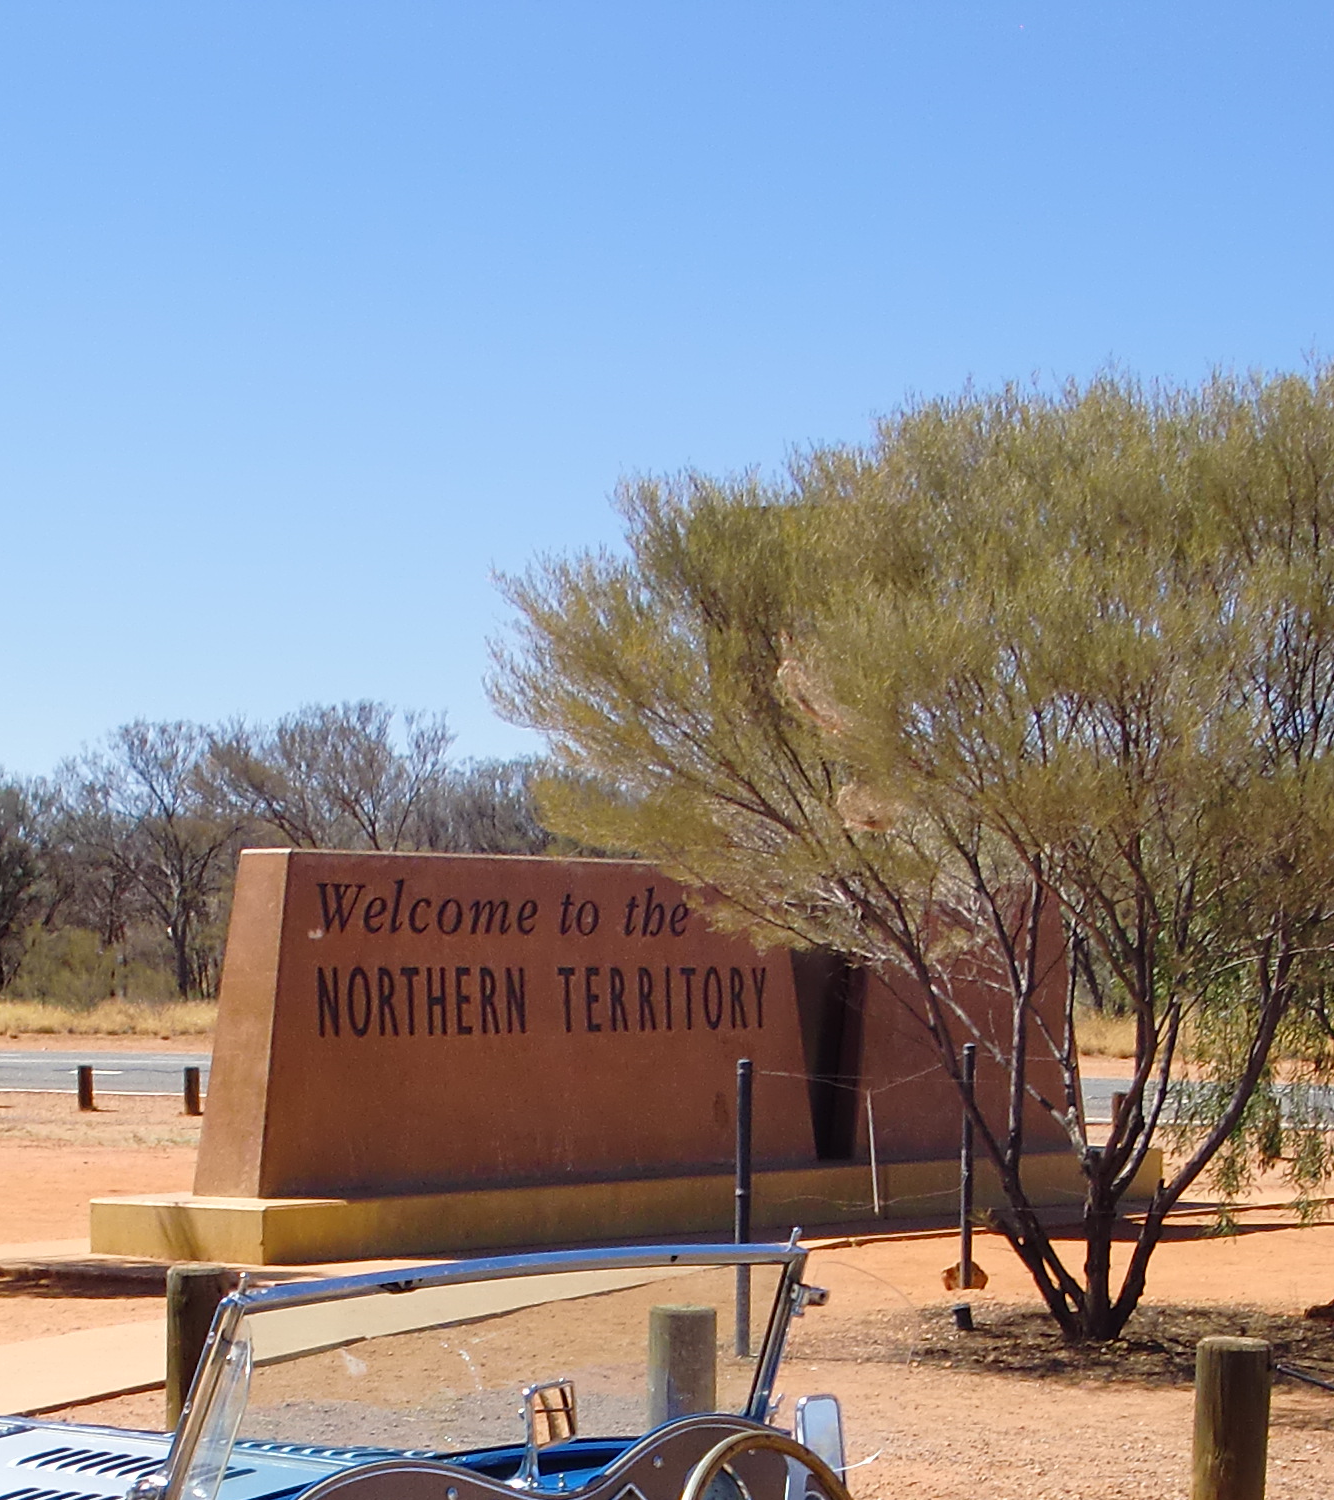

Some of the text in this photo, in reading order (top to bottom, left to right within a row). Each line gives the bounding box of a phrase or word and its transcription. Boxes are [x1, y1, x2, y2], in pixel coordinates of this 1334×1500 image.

[316, 878, 690, 938] Welcome to the
[316, 966, 767, 1038] NORTHERN TERRITORY
